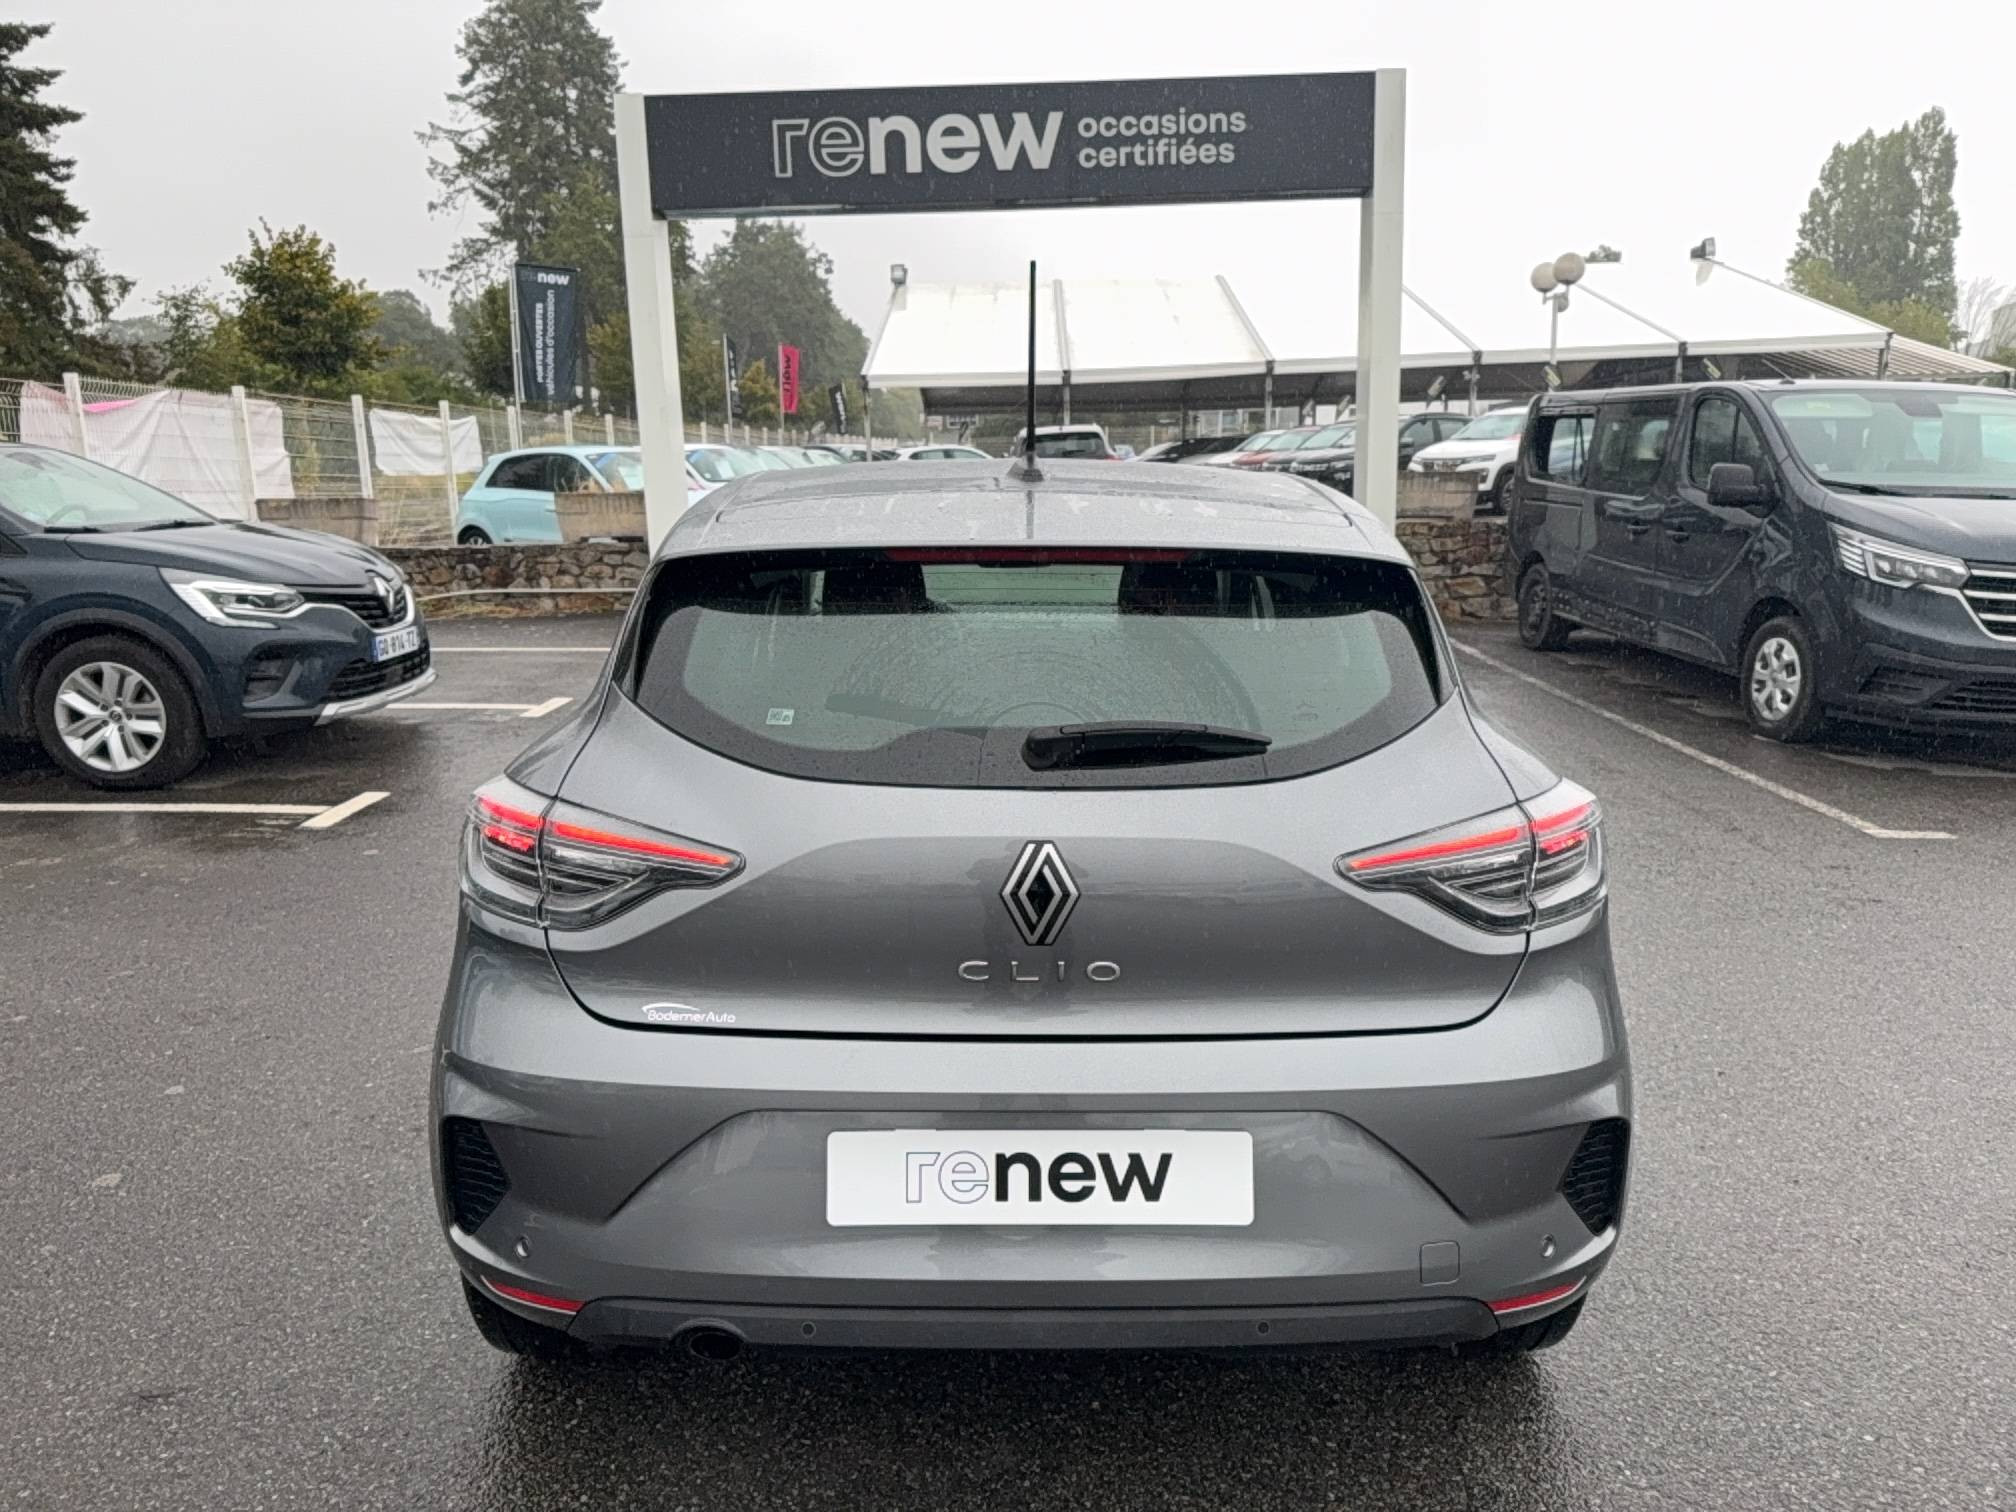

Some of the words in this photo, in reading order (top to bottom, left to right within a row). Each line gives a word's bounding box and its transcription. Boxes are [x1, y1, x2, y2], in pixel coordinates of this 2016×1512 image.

[1077, 106, 1247, 139] occasions
[772, 110, 1064, 179] renew
[1078, 137, 1236, 169] certifiées
[957, 960, 1121, 982] CLIO
[905, 1150, 1173, 1204] renew
